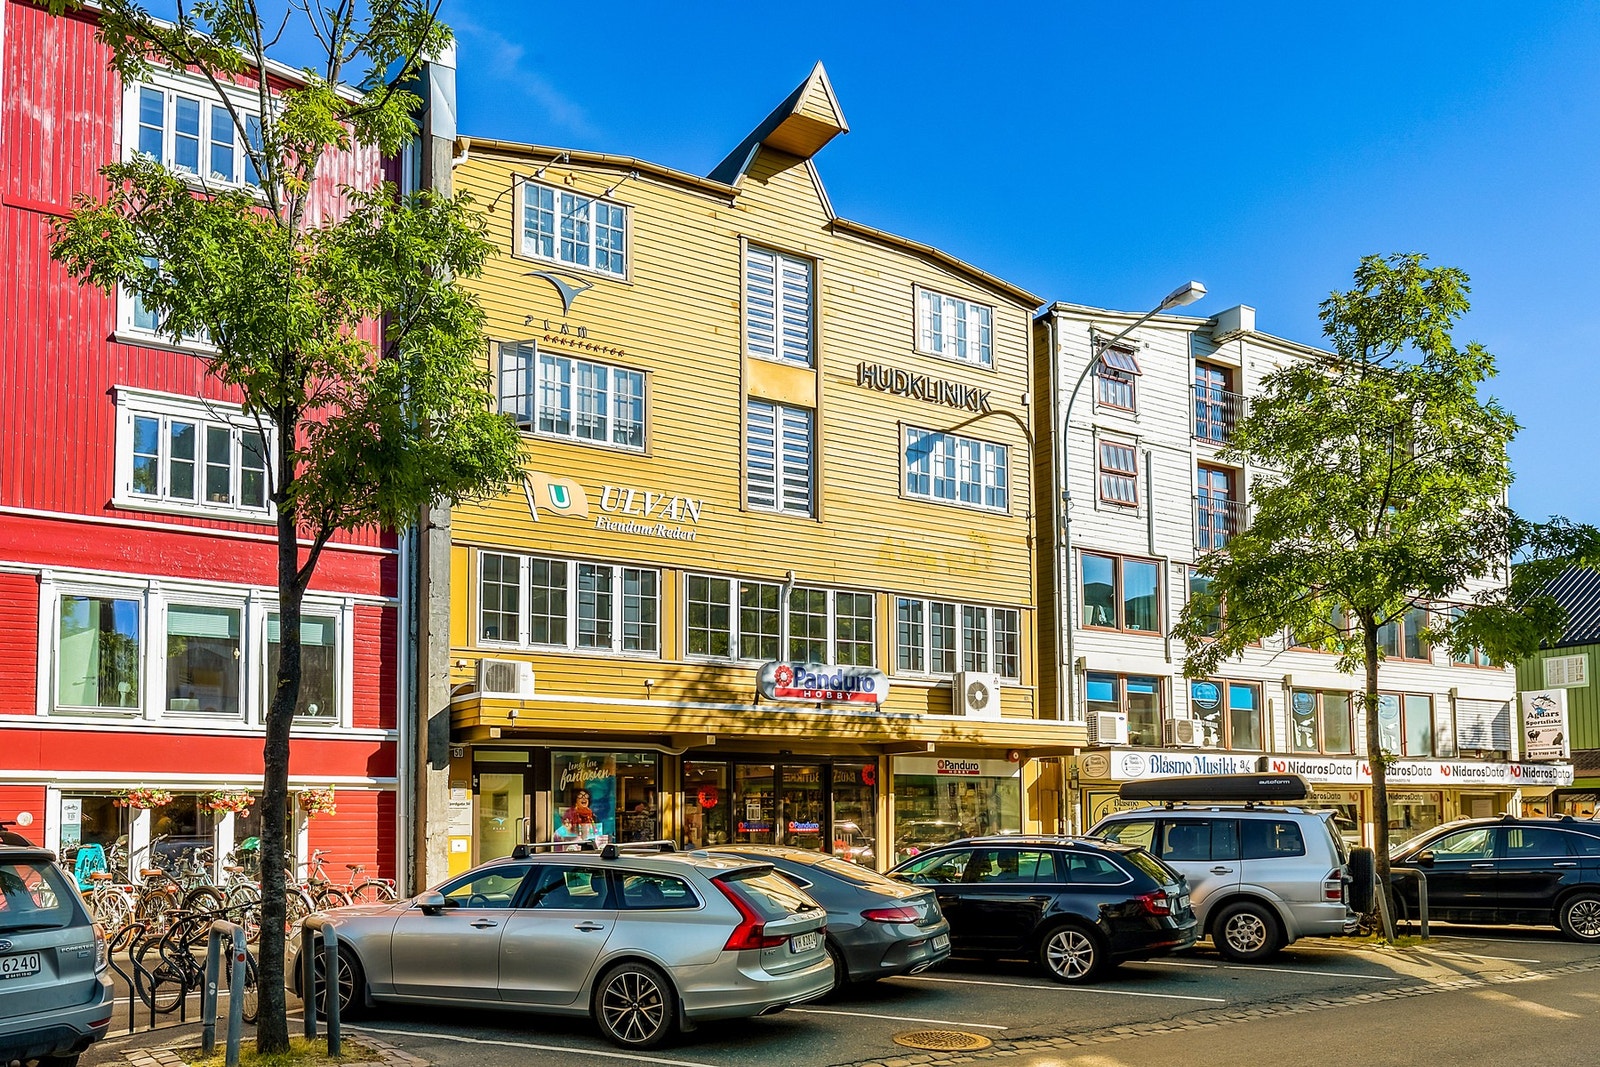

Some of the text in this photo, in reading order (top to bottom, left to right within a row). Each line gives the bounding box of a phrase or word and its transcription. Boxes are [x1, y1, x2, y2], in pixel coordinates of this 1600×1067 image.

[857, 362, 992, 414] HUDKLINIKK
[548, 483, 571, 509] U
[599, 485, 704, 524] ULVAN
[594, 516, 698, 541] Eiendom/Rederi
[793, 666, 875, 692] Panduro
[803, 690, 853, 700] HOBBY
[454, 748, 463, 757] 50
[944, 759, 979, 771] Panduro
[1149, 754, 1192, 775] Blåsmo
[1193, 756, 1237, 775] Musikk
[1288, 761, 1352, 776] NidarosData
[1385, 764, 1432, 777] darosData
[1452, 765, 1505, 778] NidarosData
[560, 768, 610, 791] fantasien
[1522, 766, 1570, 779] NidarosData
[1388, 792, 1425, 801] NidarosData
[794, 821, 819, 829] Panduro
[61, 944, 94, 953] FORESTER
[2, 956, 37, 972] 6240
